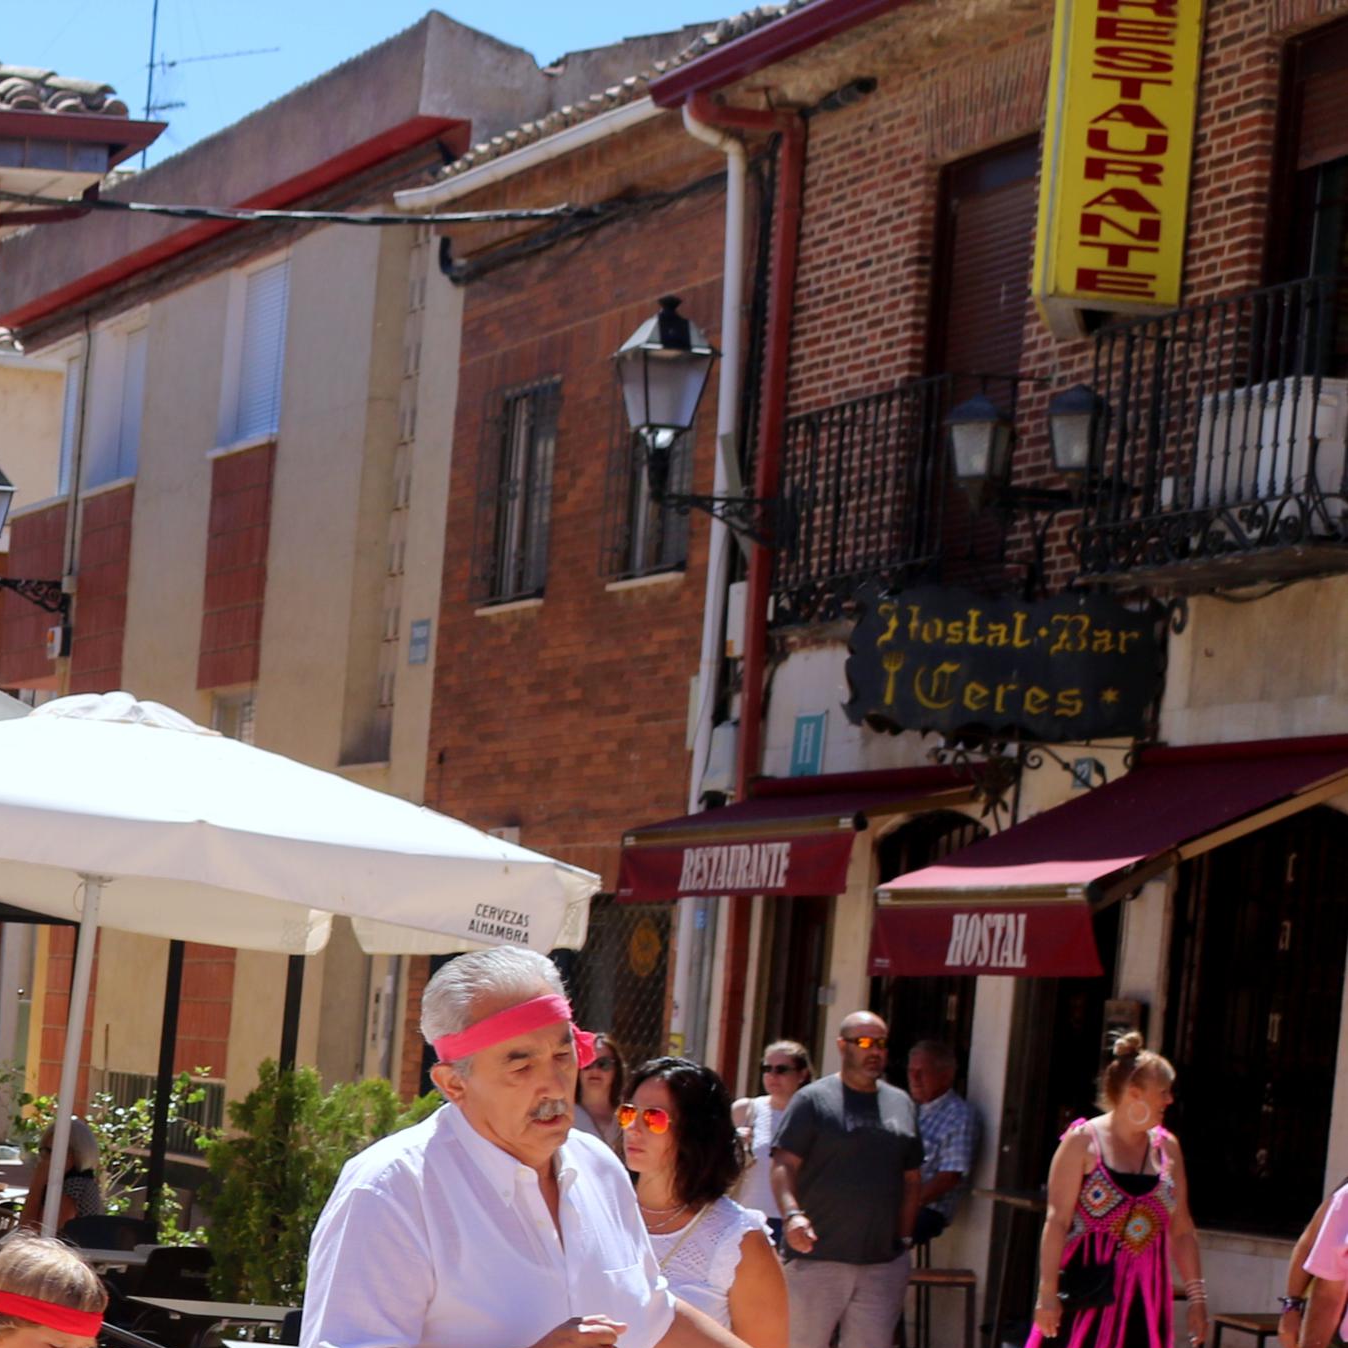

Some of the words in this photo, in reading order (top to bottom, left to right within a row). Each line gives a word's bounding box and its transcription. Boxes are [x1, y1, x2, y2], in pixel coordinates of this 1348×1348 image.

[876, 602, 1032, 648] Hostal
[1049, 613, 1141, 656] Bar
[914, 660, 1084, 718] Ceres
[678, 842, 792, 892] RESTAURANTE
[468, 919, 530, 944] ALHAMBRA
[474, 903, 530, 928] CERVEZAS
[945, 912, 1028, 969] HOSTAL
